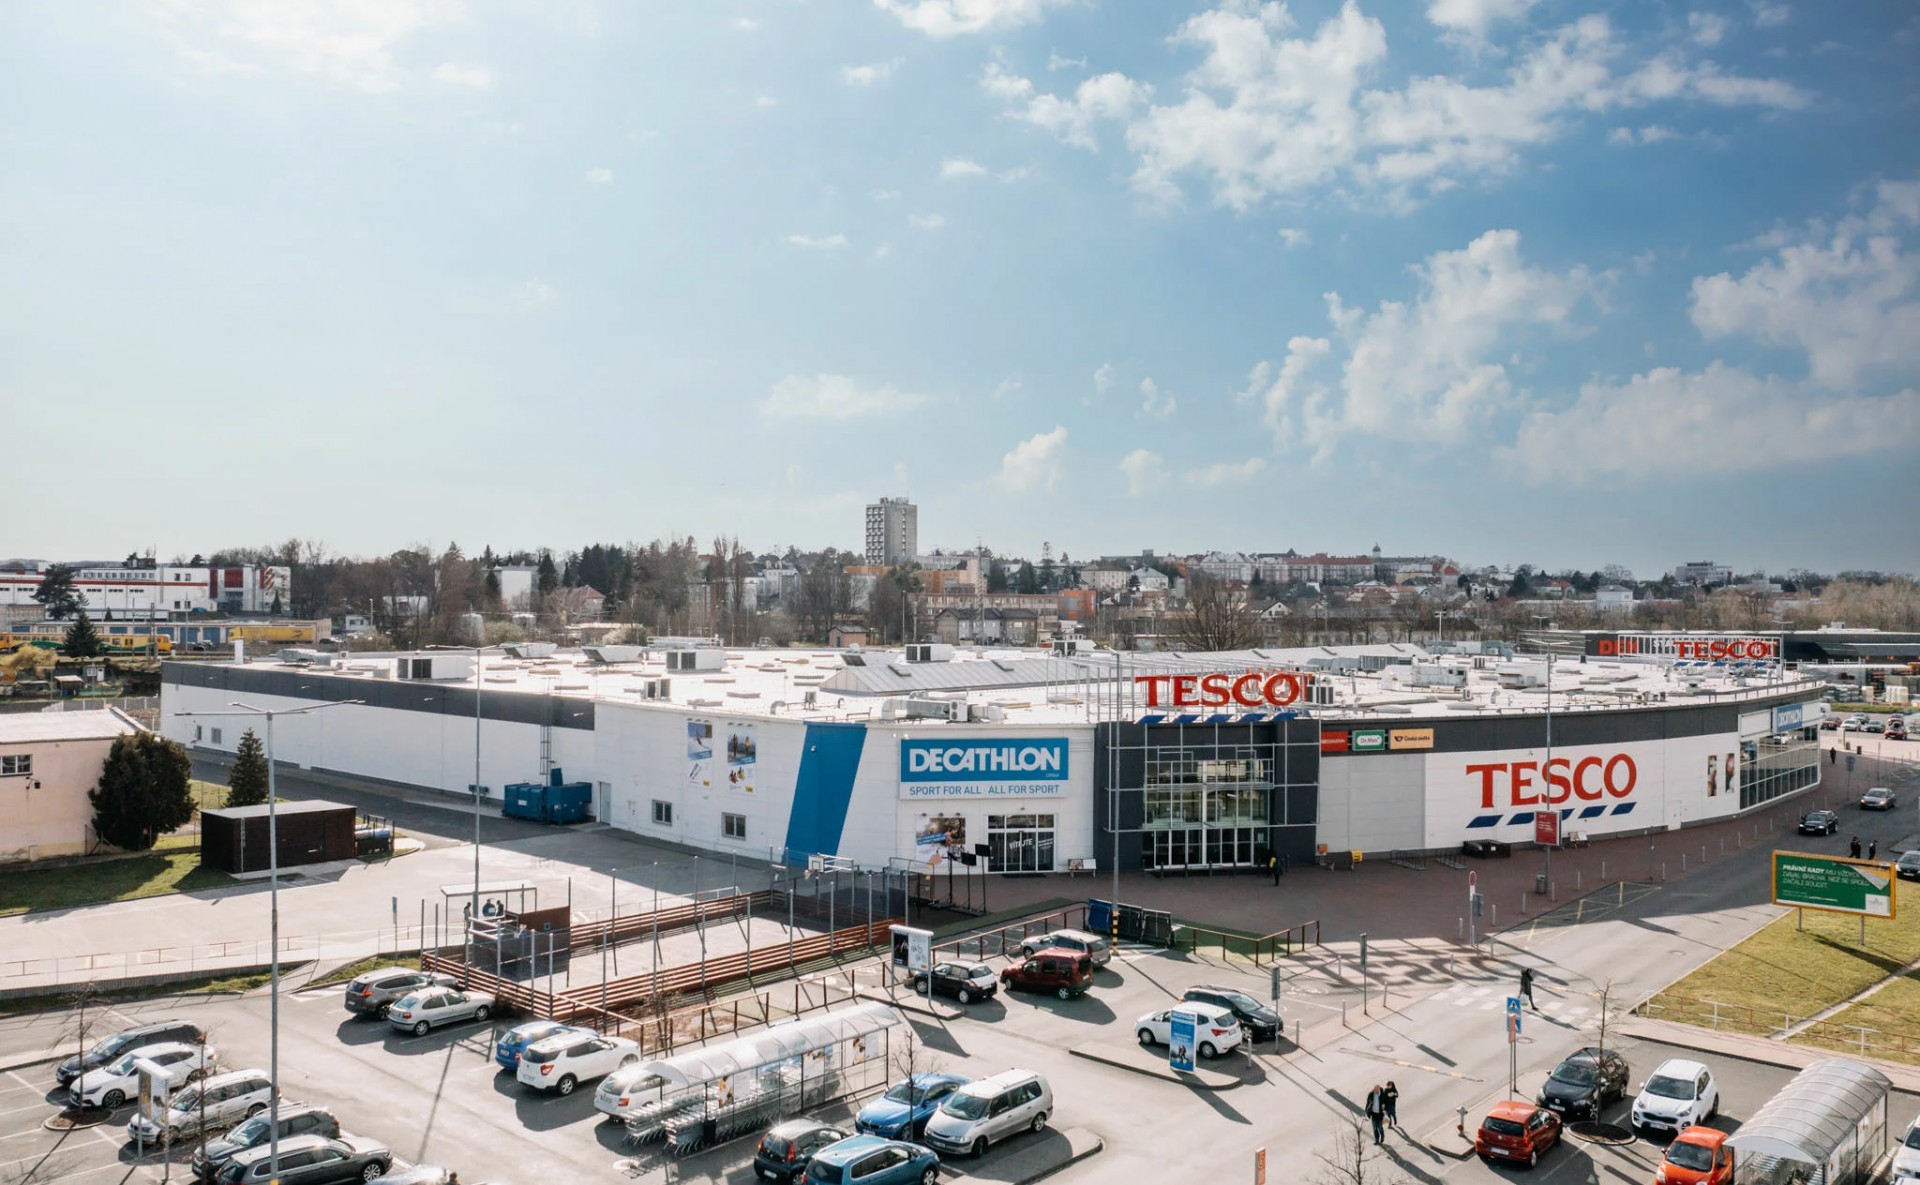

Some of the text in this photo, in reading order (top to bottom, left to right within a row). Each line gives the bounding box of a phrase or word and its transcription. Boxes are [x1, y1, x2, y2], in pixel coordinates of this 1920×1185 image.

[1673, 640, 1769, 659] TESCO
[1135, 674, 1300, 707] TESCO
[909, 747, 1061, 773] DECATHLON
[909, 784, 1060, 796] SPORT FOR ALL ALL FOR SPORT
[1465, 753, 1638, 808] TESCO
